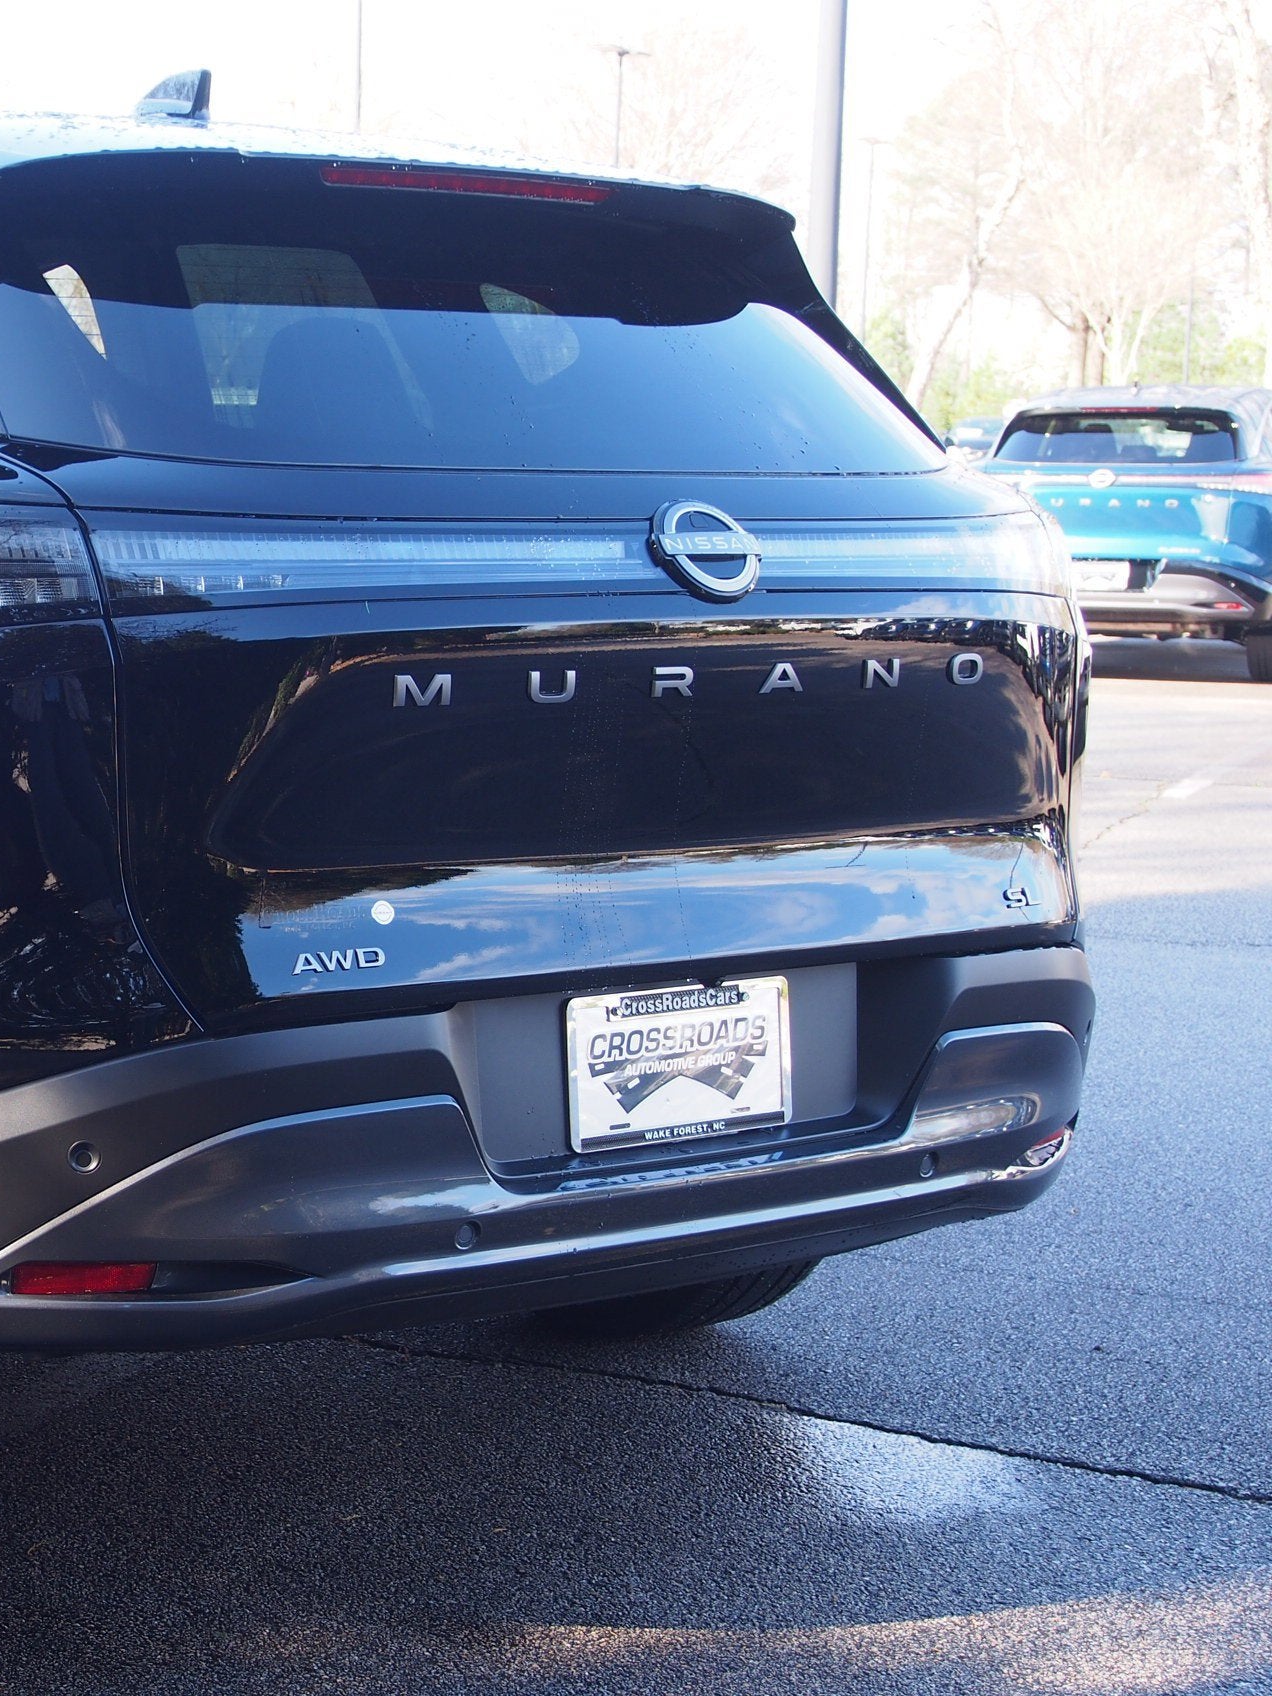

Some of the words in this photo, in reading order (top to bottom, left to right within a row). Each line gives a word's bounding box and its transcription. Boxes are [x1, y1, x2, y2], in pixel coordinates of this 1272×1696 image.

[1050, 498, 1179, 508] URANO
[664, 535, 760, 551] NISSAN
[392, 652, 985, 708] MURANO
[1003, 887, 1042, 909] SL
[291, 947, 386, 976] AWD
[620, 989, 739, 1016] CrossRoadsCars
[588, 1015, 767, 1060] CROSSROADS
[623, 1060, 695, 1077] AUTOMOTIVE
[697, 1051, 736, 1067] GROUP
[644, 1128, 671, 1141] WAKE
[673, 1123, 711, 1136] FOREST,
[713, 1121, 726, 1130] NC
